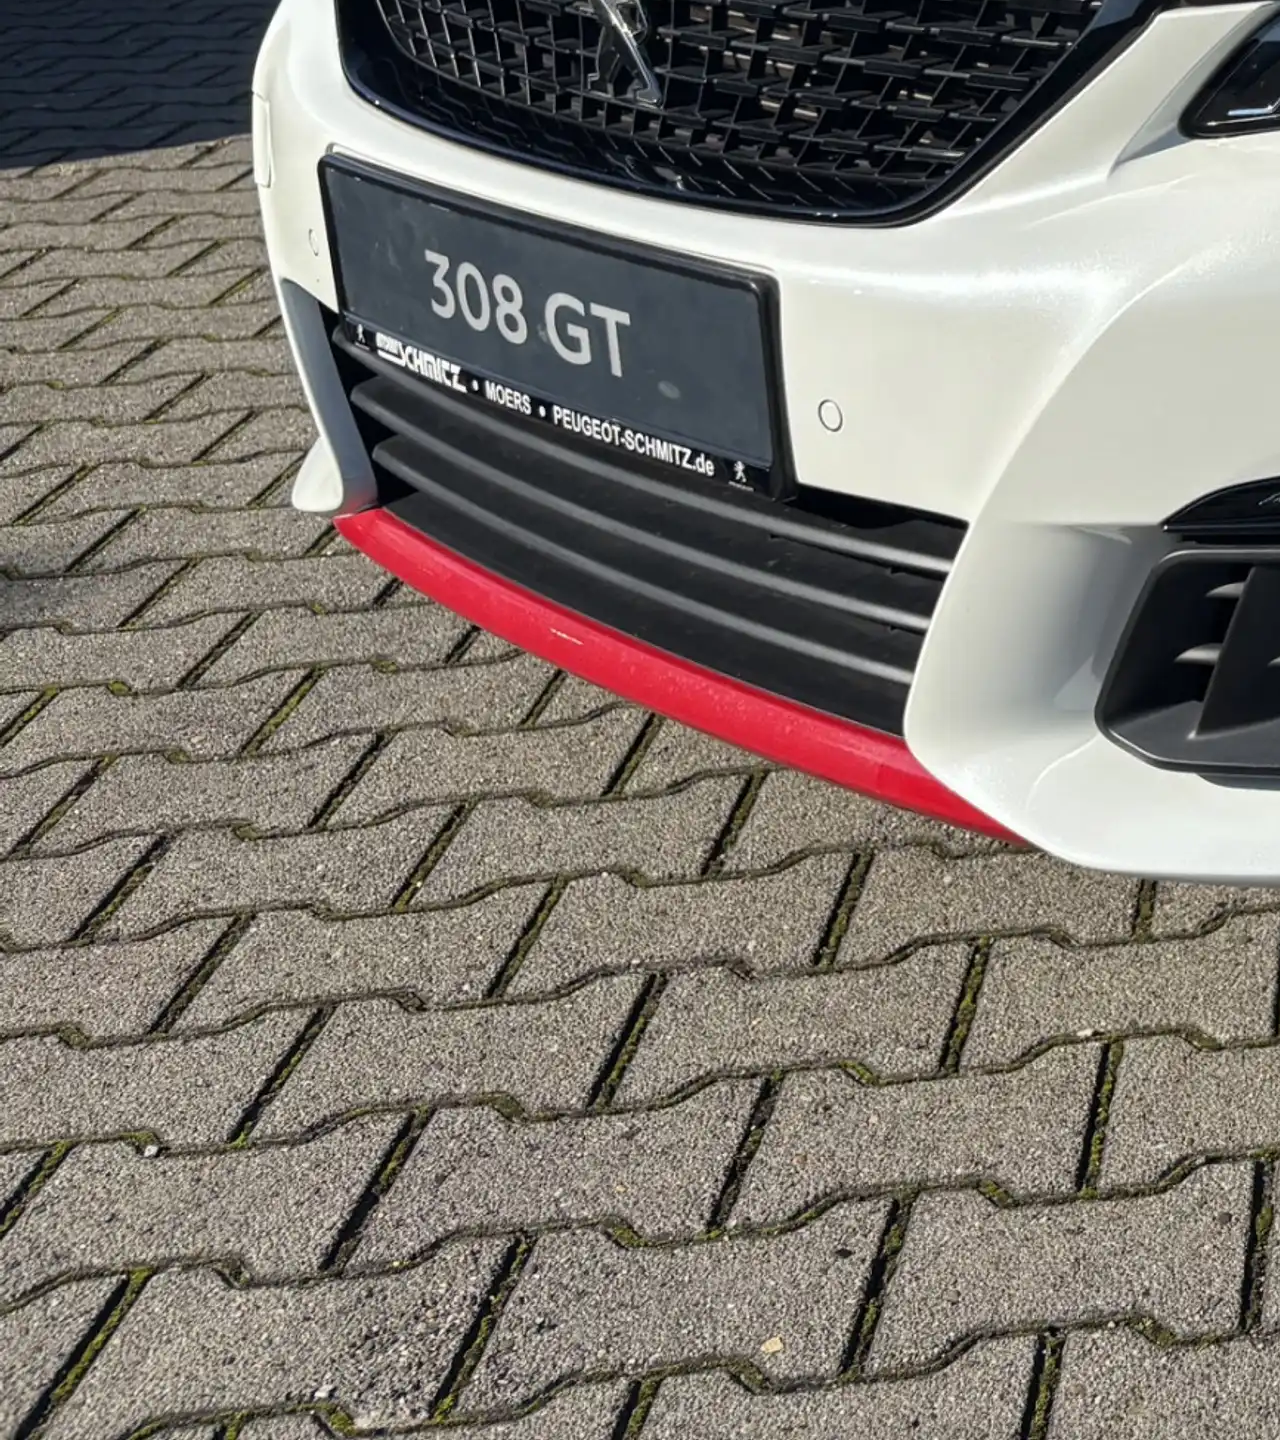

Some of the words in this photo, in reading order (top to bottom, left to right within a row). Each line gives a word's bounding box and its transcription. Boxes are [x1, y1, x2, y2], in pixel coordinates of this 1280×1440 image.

[423, 248, 530, 346] 308
[544, 291, 632, 378] GT
[484, 379, 532, 417] MOERS
[552, 404, 715, 478] PEUGEOT-SCHMITZ.de
